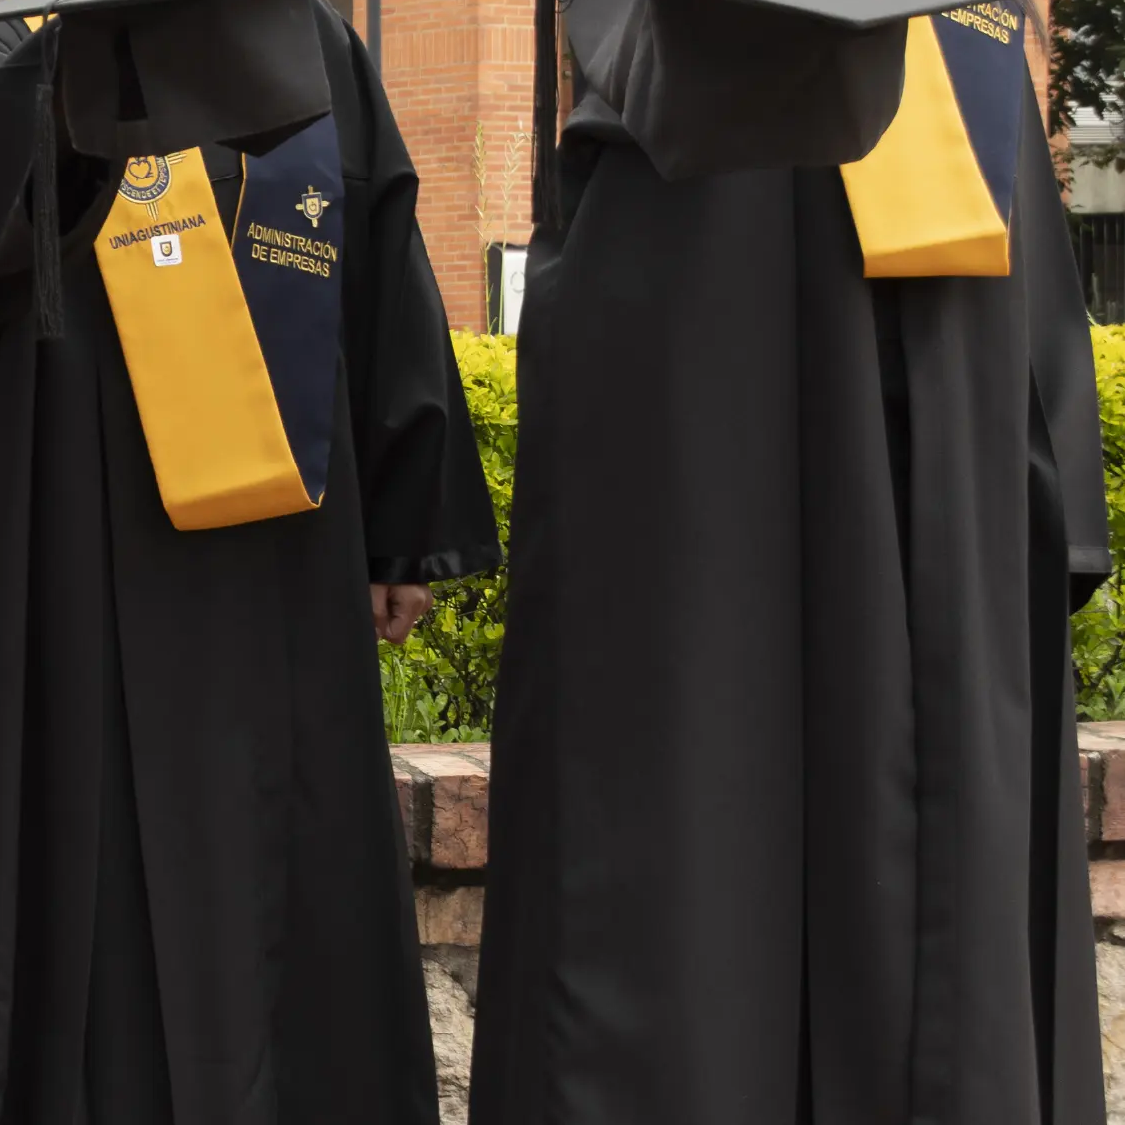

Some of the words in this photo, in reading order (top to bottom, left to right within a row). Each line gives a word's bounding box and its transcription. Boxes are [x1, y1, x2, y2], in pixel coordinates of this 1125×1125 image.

[950, 8, 1010, 45] EMPRESAS
[109, 214, 206, 250] UNIAGUSTINIANA
[247, 222, 337, 262] ADMINISTRACIÓN
[251, 243, 267, 261] DE
[270, 248, 330, 277] EMPRESAS
